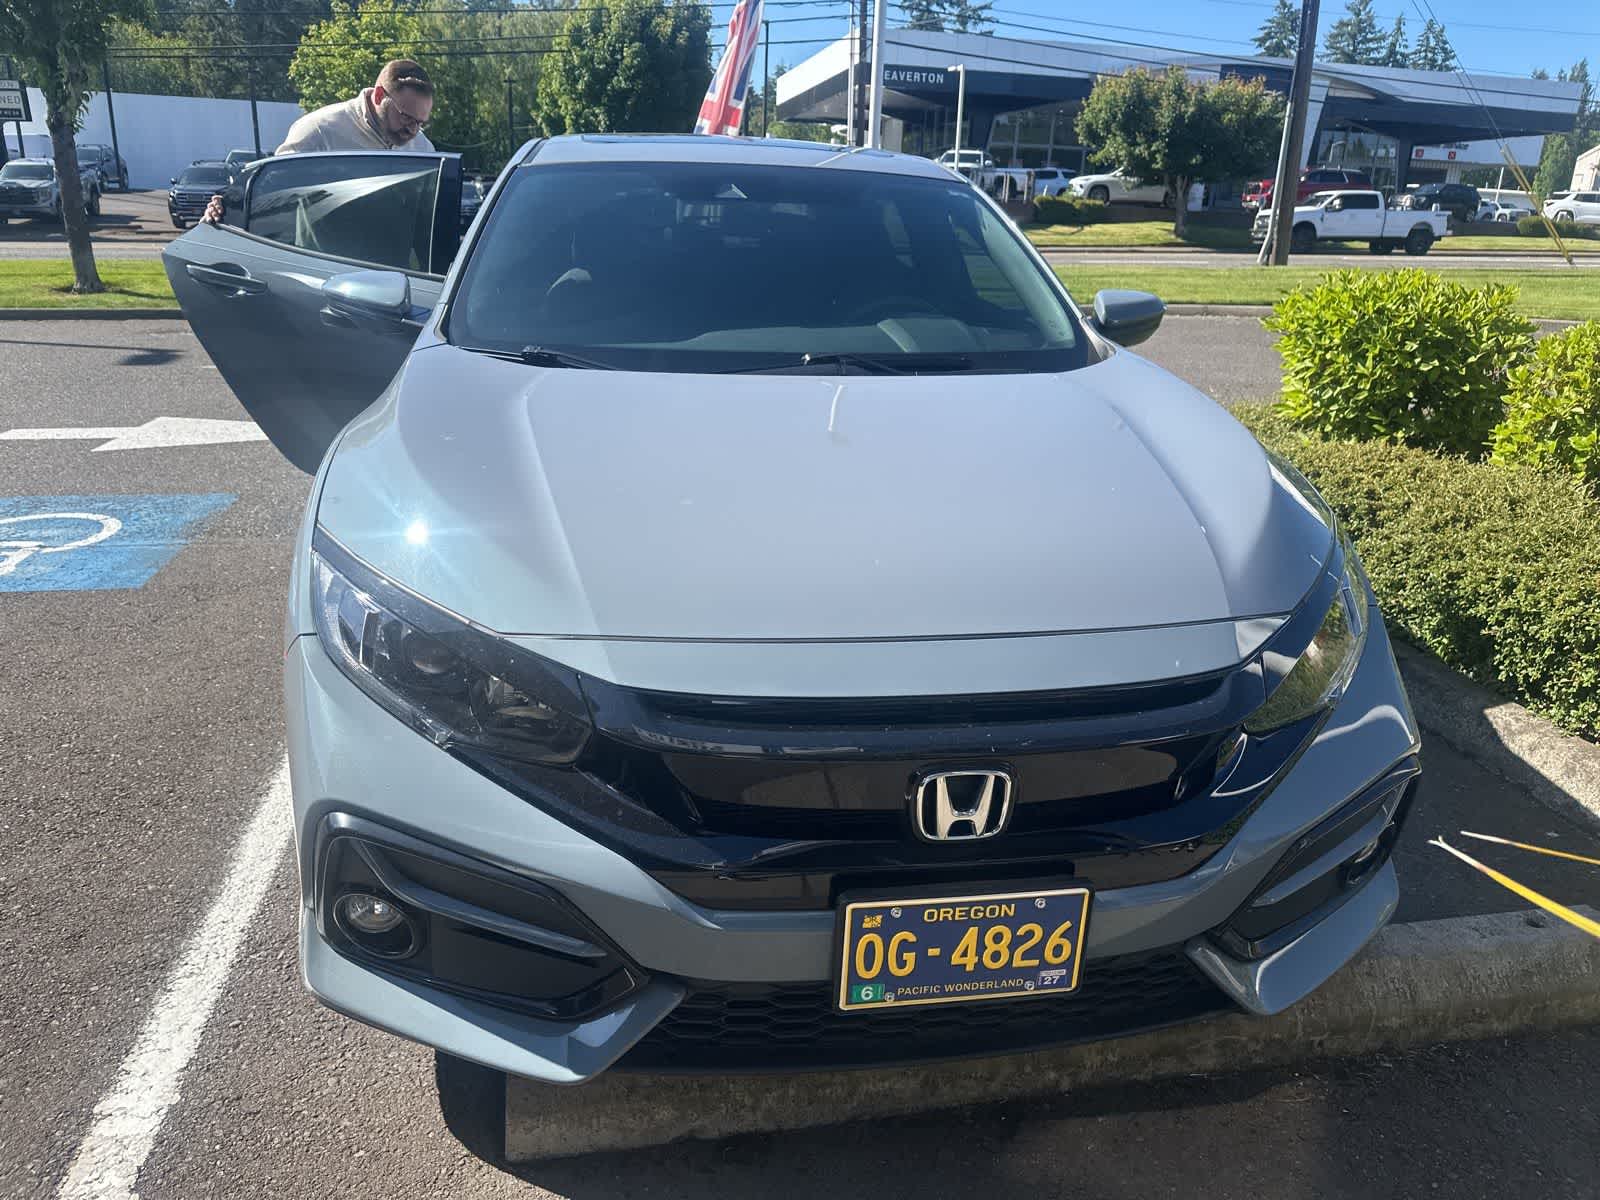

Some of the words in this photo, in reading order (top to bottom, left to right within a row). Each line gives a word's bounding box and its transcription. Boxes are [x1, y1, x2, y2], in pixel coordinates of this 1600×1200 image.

[884, 70, 944, 84] EAVERTON
[923, 903, 1016, 923] OREGON
[897, 984, 941, 996] PACIFIC
[944, 978, 1024, 993] WONDERLAND
[1043, 976, 1060, 985] 27
[860, 986, 874, 1001] 6
